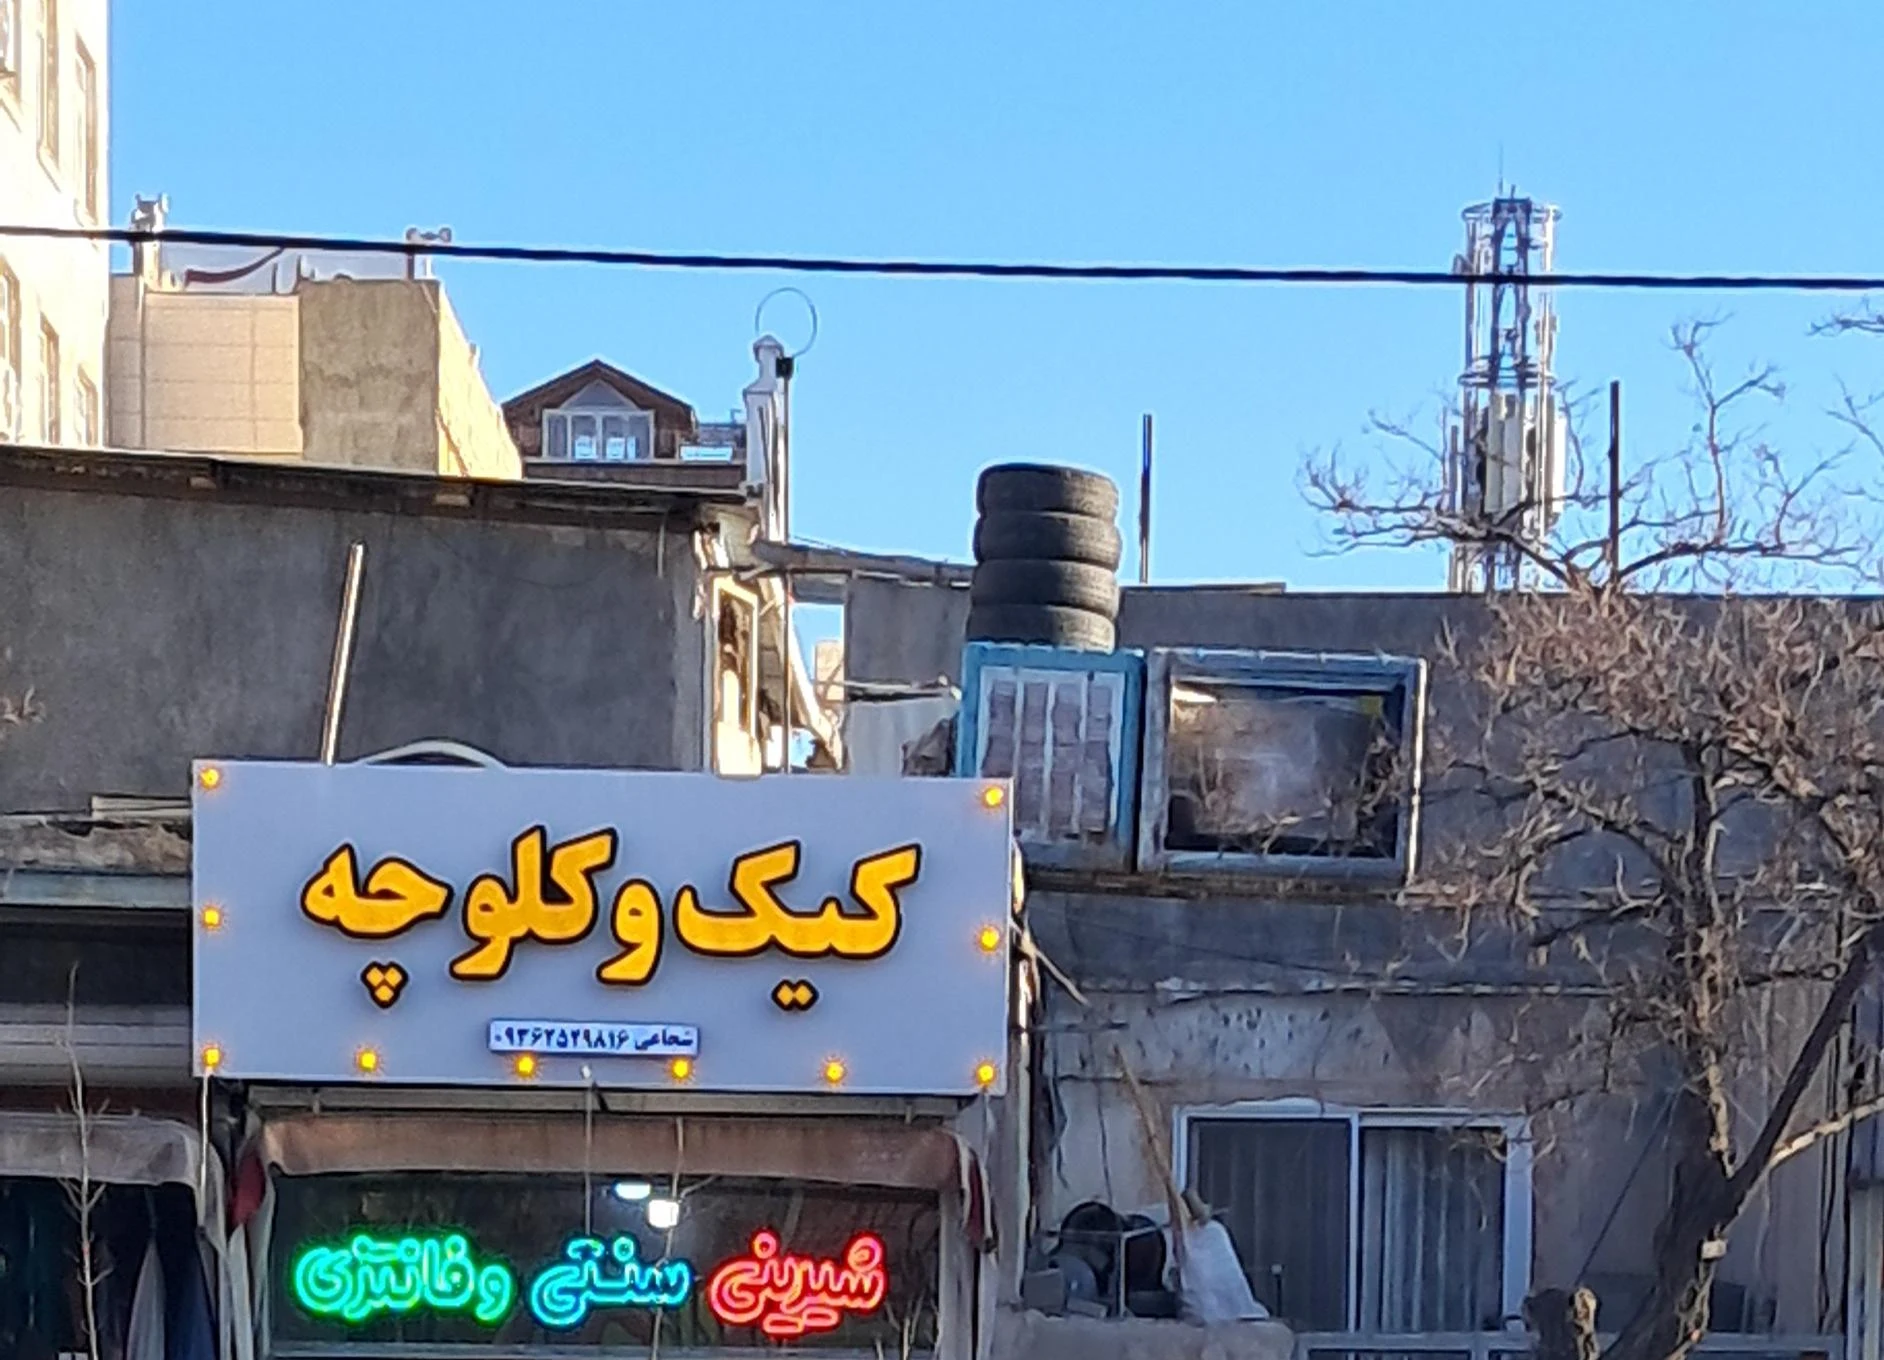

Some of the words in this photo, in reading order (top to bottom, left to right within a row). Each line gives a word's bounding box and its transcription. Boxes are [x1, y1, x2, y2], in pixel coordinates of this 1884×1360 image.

[300, 824, 619, 1010] کلوچه
[595, 877, 665, 985] و
[673, 839, 923, 1011] کیک
[295, 1234, 474, 1320] فانتزی
[475, 1264, 512, 1320] و
[530, 1236, 691, 1326] سنتی
[709, 1231, 885, 1334] شیرینی
